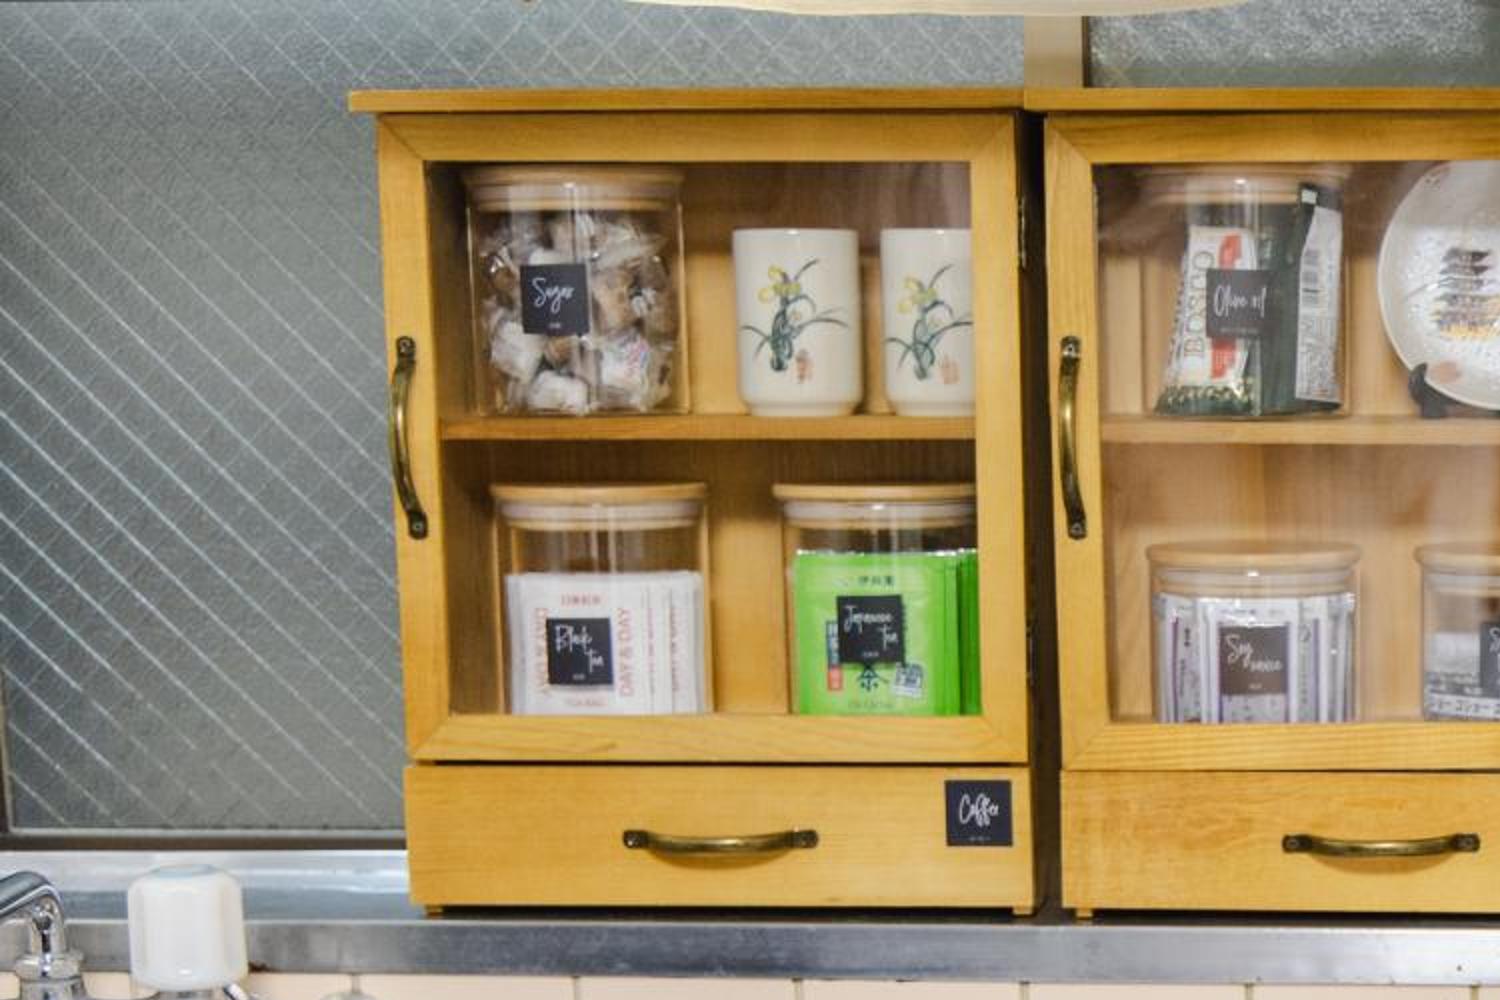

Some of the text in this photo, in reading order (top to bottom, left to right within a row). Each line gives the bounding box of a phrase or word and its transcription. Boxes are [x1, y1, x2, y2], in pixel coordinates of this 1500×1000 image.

[532, 277, 575, 314] Sugar
[1213, 285, 1267, 318] Olive oil
[555, 624, 593, 654] Black
[1225, 634, 1254, 668] Soy
[959, 794, 999, 827] Coffee
